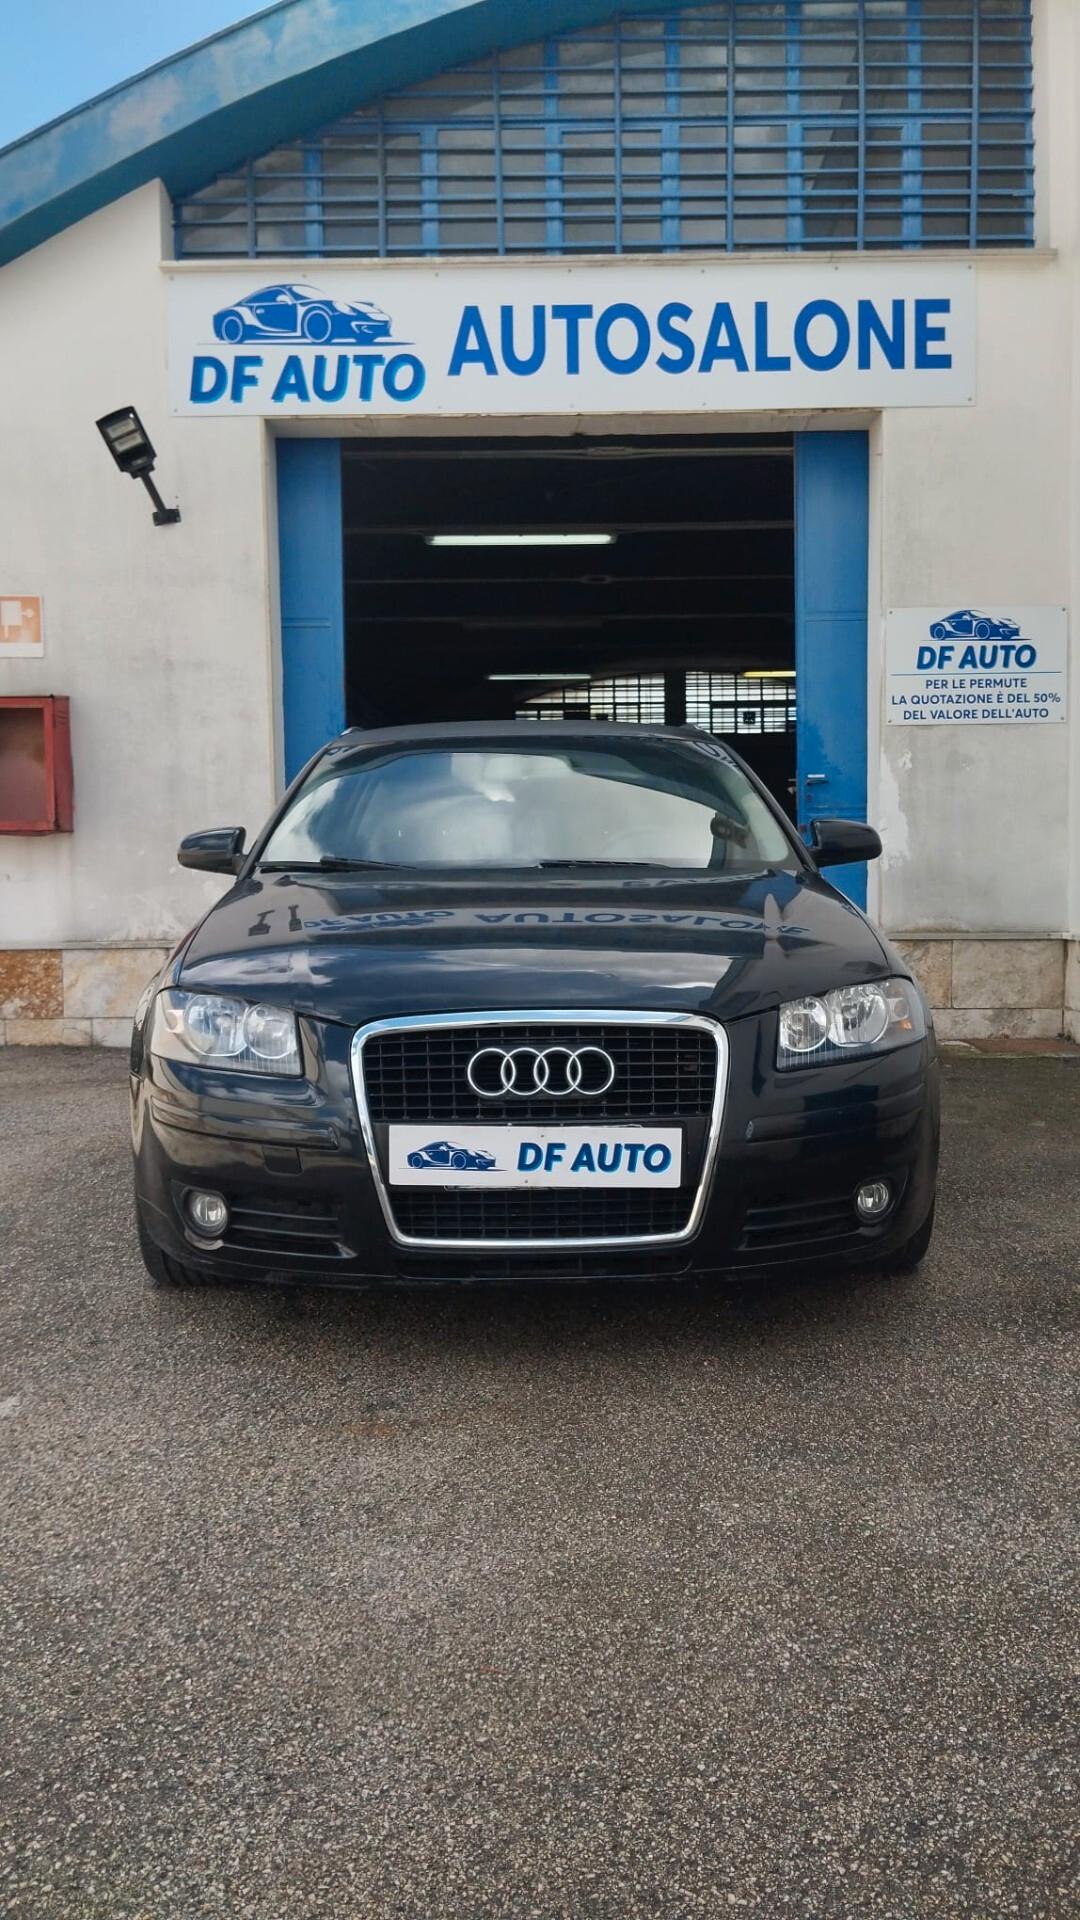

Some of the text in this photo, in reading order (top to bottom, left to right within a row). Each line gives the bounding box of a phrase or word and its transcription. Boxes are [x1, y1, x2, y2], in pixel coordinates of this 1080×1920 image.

[447, 298, 952, 376] AUTOSALONE
[189, 353, 426, 404] DF AUTO
[916, 644, 1037, 670] DF AUTO
[925, 677, 1028, 690] PER LE PERMUTE
[891, 691, 1061, 705] LA QUOTAZIONE È DEL 50%
[903, 708, 1049, 721] DEL VALORE DELL'AUTO
[517, 1142, 672, 1173] DF AUTO
